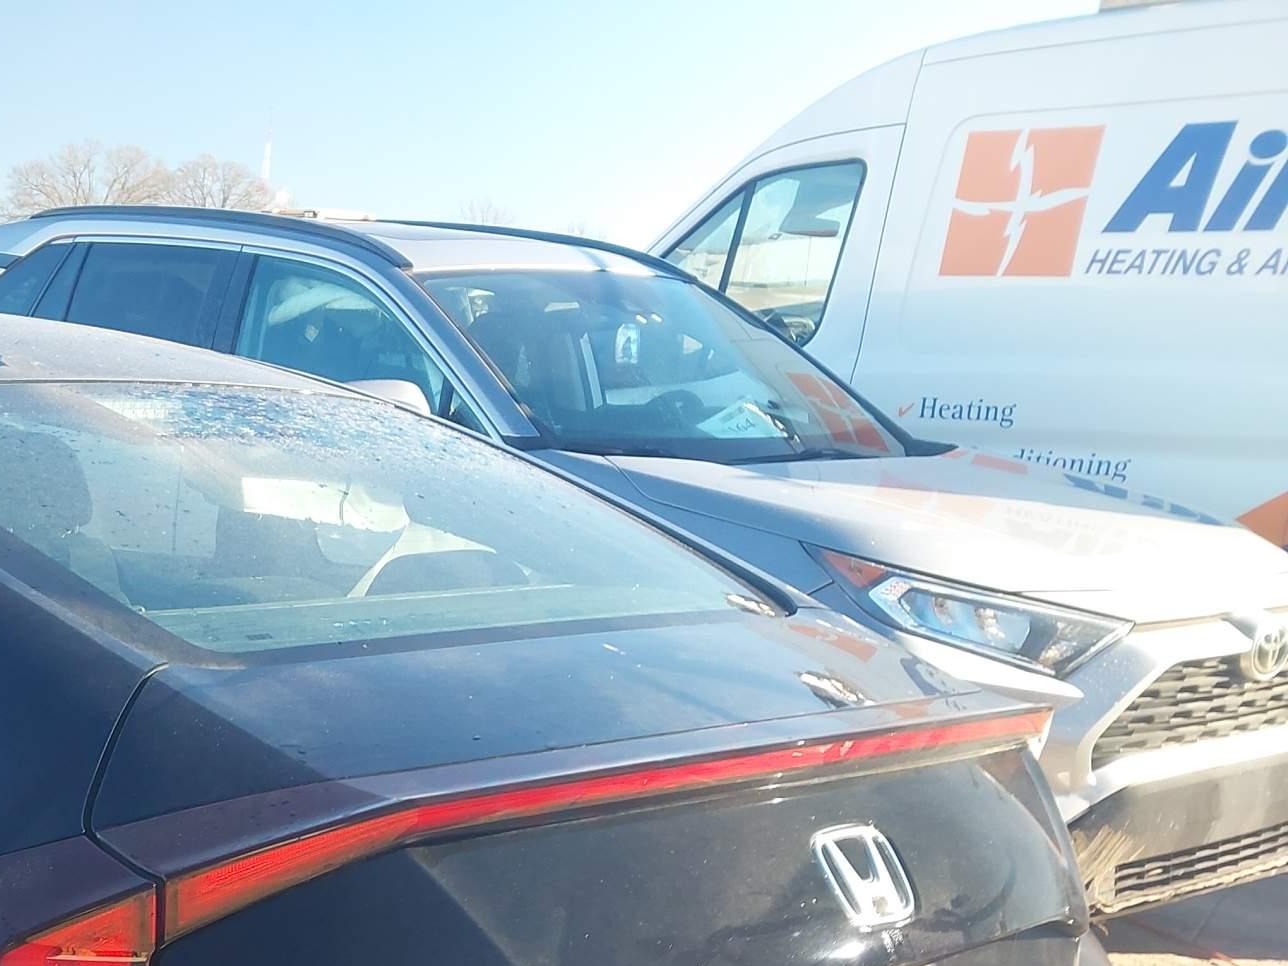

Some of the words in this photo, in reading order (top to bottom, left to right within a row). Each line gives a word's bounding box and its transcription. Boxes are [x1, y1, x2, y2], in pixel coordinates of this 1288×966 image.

[1084, 248, 1221, 276] HEATING
[1226, 248, 1251, 276] &
[919, 396, 1017, 428] Heating
